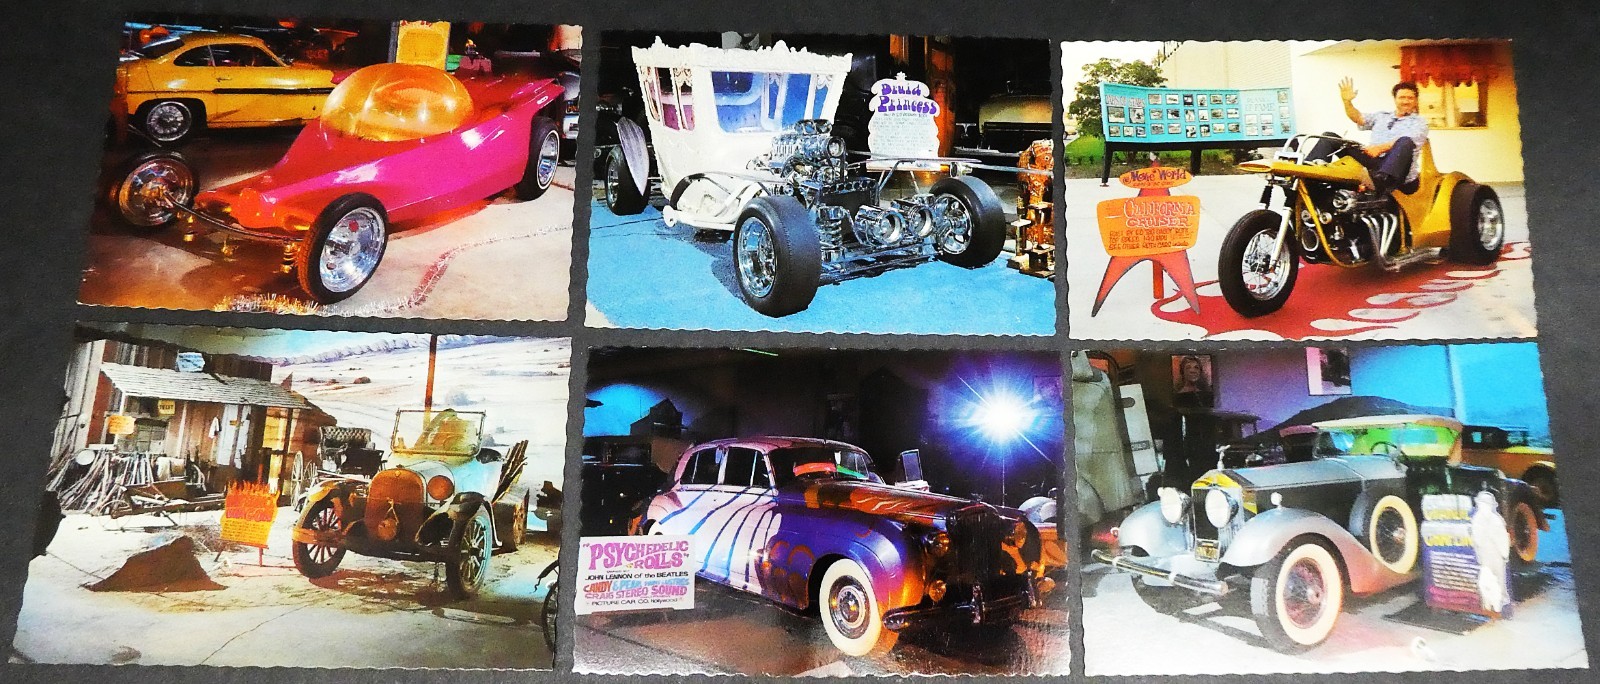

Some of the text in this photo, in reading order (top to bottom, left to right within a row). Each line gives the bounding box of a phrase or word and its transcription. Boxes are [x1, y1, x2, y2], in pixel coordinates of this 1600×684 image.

[881, 83, 921, 96] Druid
[878, 96, 937, 114] Princess
[1159, 169, 1187, 180] World
[1124, 198, 1196, 218] CALIFORNIA
[1126, 216, 1193, 228] CRUISER
[583, 581, 613, 593] CANDY
[585, 585, 688, 600] CRAIG STEREO SOUND
